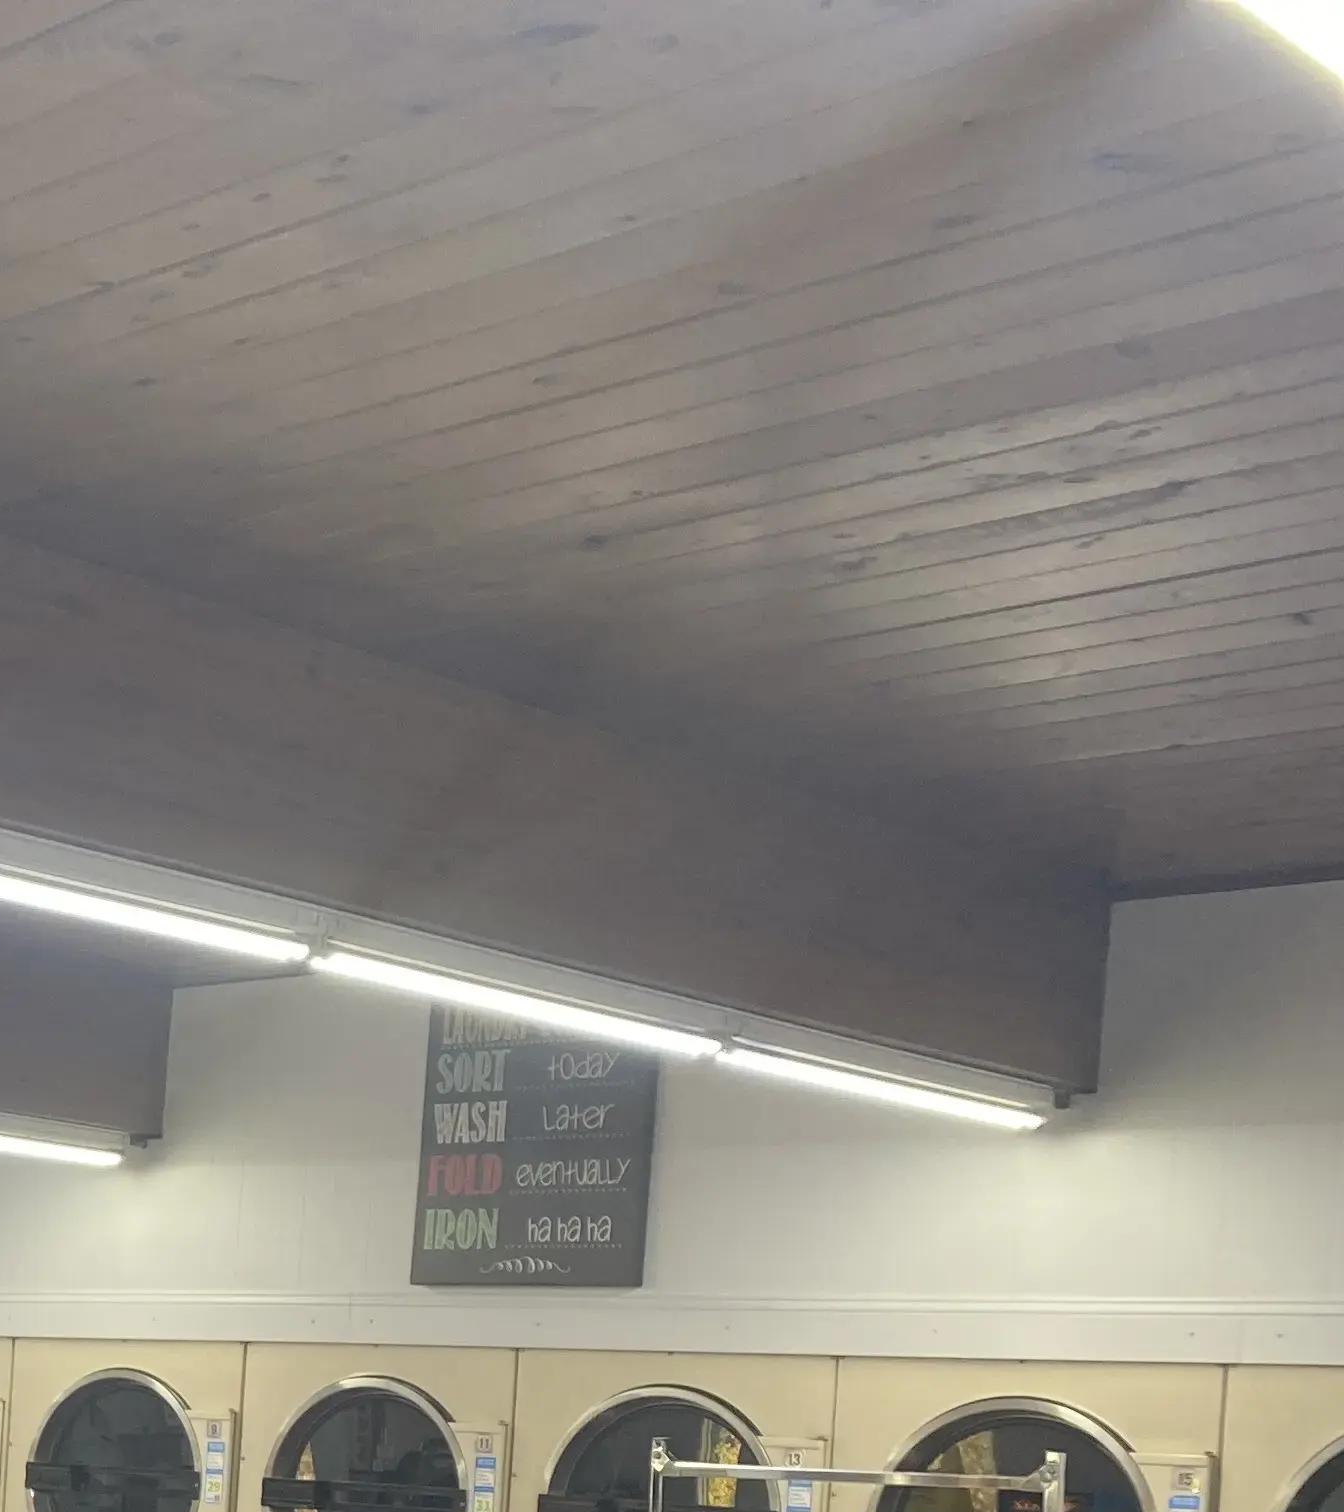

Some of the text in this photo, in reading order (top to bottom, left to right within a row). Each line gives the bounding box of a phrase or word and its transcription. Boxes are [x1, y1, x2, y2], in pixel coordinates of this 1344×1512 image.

[436, 1050, 511, 1094] SORT
[434, 1100, 614, 1144] WASH Later
[427, 1154, 502, 1196] FOLD
[423, 1208, 612, 1251] IRON ha ha ha
[789, 1453, 800, 1465] 13
